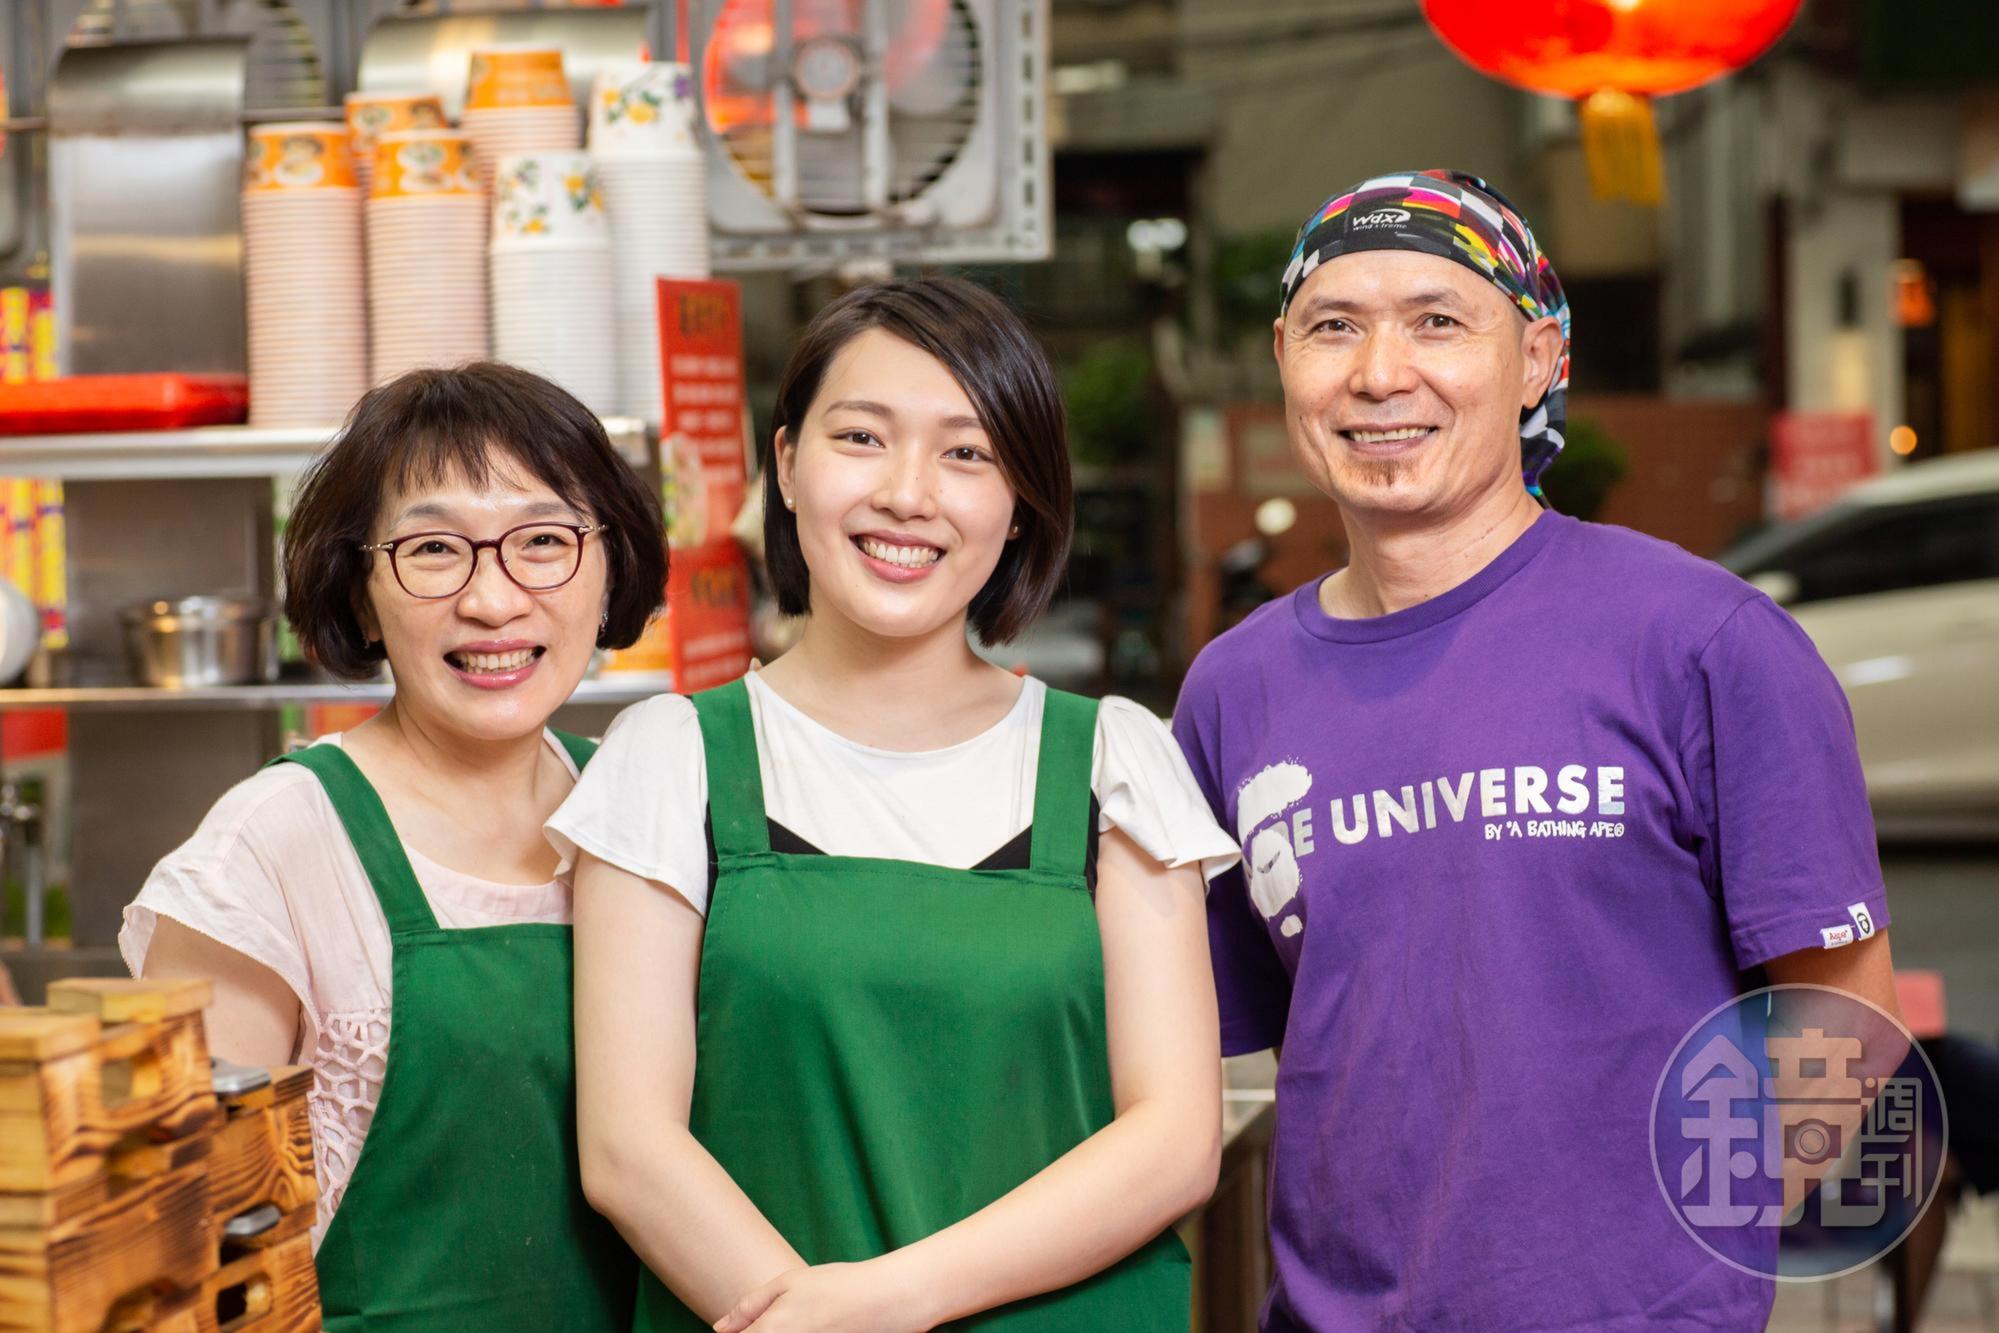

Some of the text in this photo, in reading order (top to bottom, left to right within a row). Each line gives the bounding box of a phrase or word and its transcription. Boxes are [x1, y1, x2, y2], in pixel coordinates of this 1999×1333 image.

[1330, 764, 1625, 845] UNIVERSE
[1484, 823, 1503, 840] BY
[1527, 820, 1587, 838] BATHING
